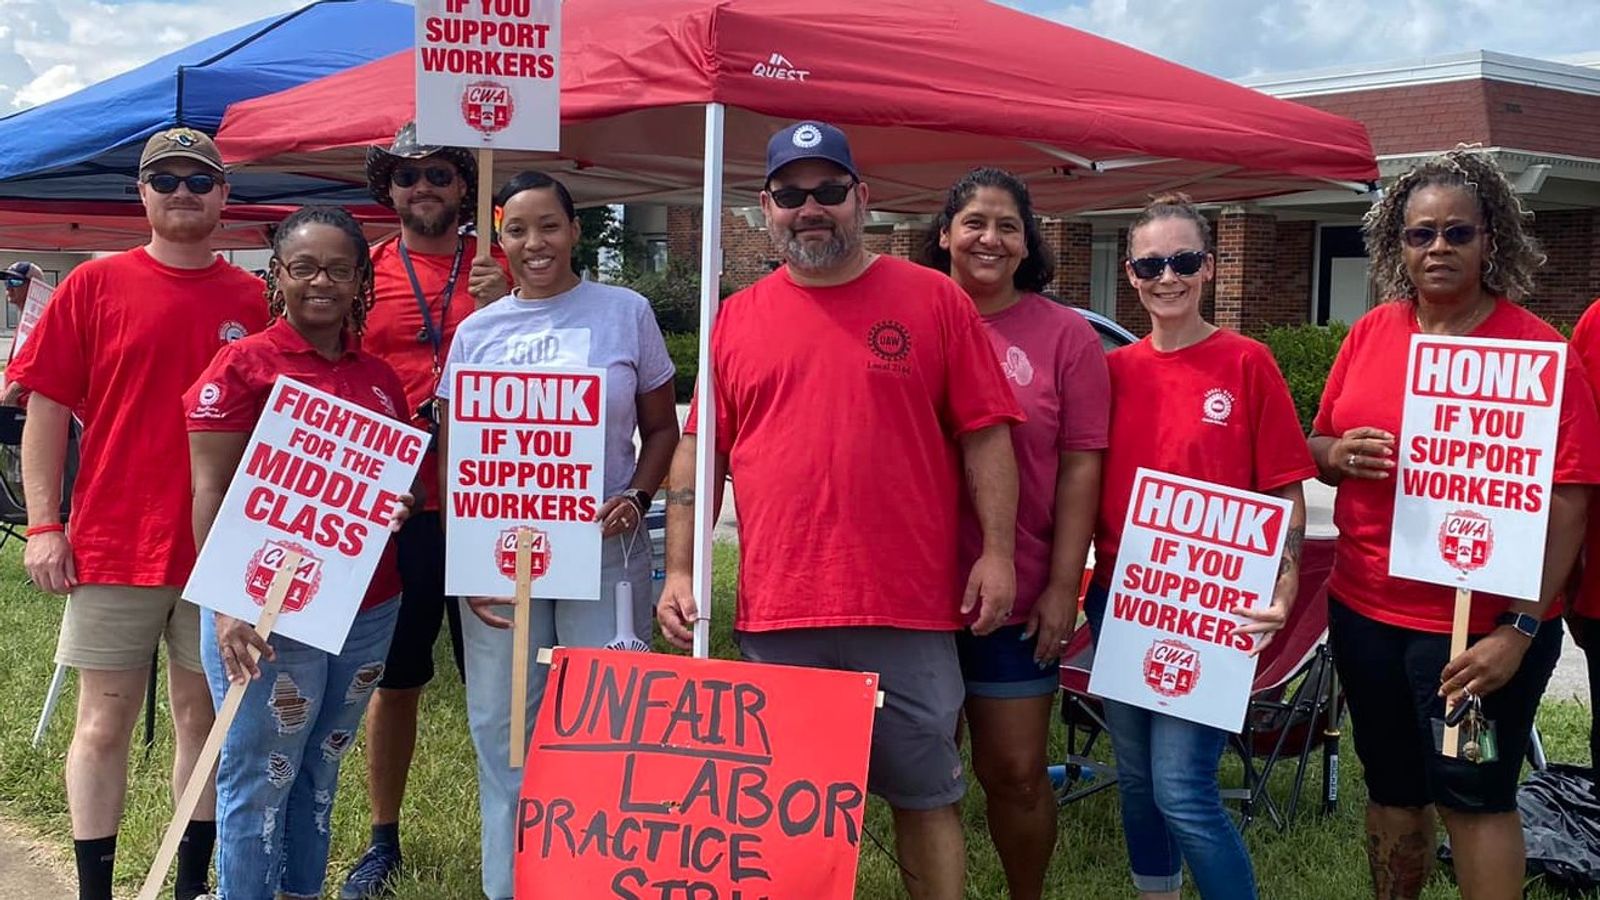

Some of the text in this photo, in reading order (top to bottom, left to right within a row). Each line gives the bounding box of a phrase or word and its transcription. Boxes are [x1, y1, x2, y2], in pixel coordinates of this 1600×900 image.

[426, 17, 550, 48] SUPPORT
[421, 47, 554, 79] WORKERS
[752, 62, 810, 82] QUEST
[469, 87, 505, 103] CWA
[511, 335, 559, 365] GOD
[1417, 347, 1551, 402] HONK
[460, 375, 593, 422] HONK
[273, 384, 423, 465] FIGHTING
[481, 428, 572, 457] IF YOU
[1434, 404, 1525, 439] IF YOU
[288, 428, 385, 480] FOR THE
[459, 460, 592, 489] SUPPORT
[1410, 435, 1542, 477] SUPPORT
[246, 442, 400, 527] MIDDLE
[1403, 468, 1543, 513] WORKERS
[244, 486, 369, 557] CLASS
[453, 492, 597, 522] WORKERS
[1137, 481, 1276, 551] HONK
[1448, 518, 1487, 536] CWA
[1150, 537, 1244, 581] IF YOU
[1123, 563, 1259, 614] SUPPORT
[1112, 592, 1255, 651] WORKERS
[1154, 645, 1193, 668] CWA
[554, 656, 772, 756] UNFAIR
[619, 752, 863, 846] LABOR
[517, 797, 772, 882] PRACTICE
